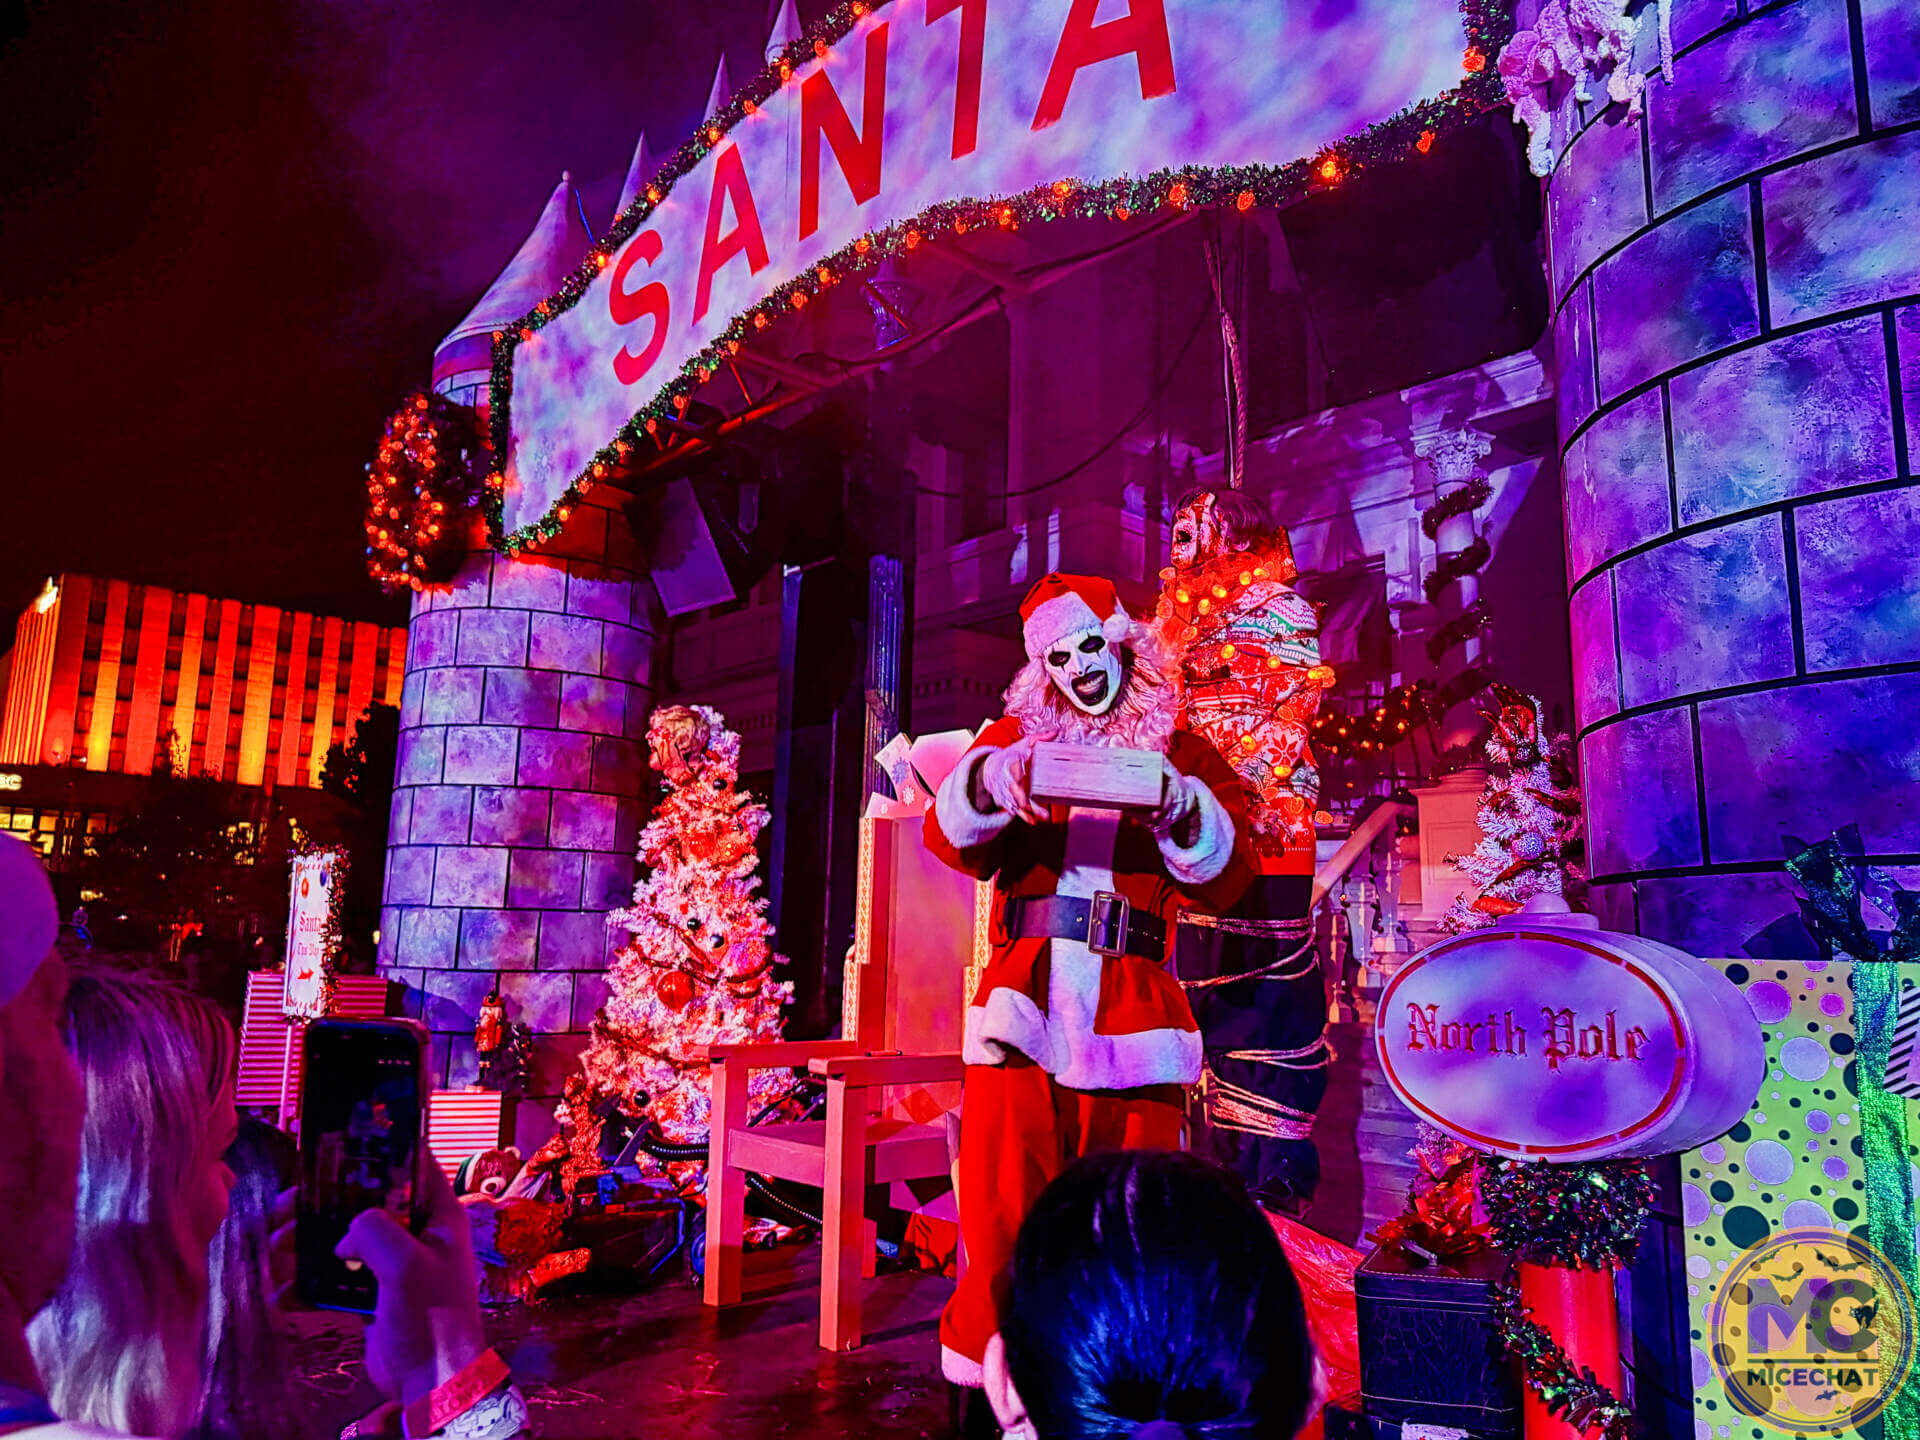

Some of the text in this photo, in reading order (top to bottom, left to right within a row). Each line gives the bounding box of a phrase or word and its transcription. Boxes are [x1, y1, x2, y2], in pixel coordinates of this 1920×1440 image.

[608, 0, 1177, 386] SANTA
[1406, 1002, 1652, 1074] North Pole
